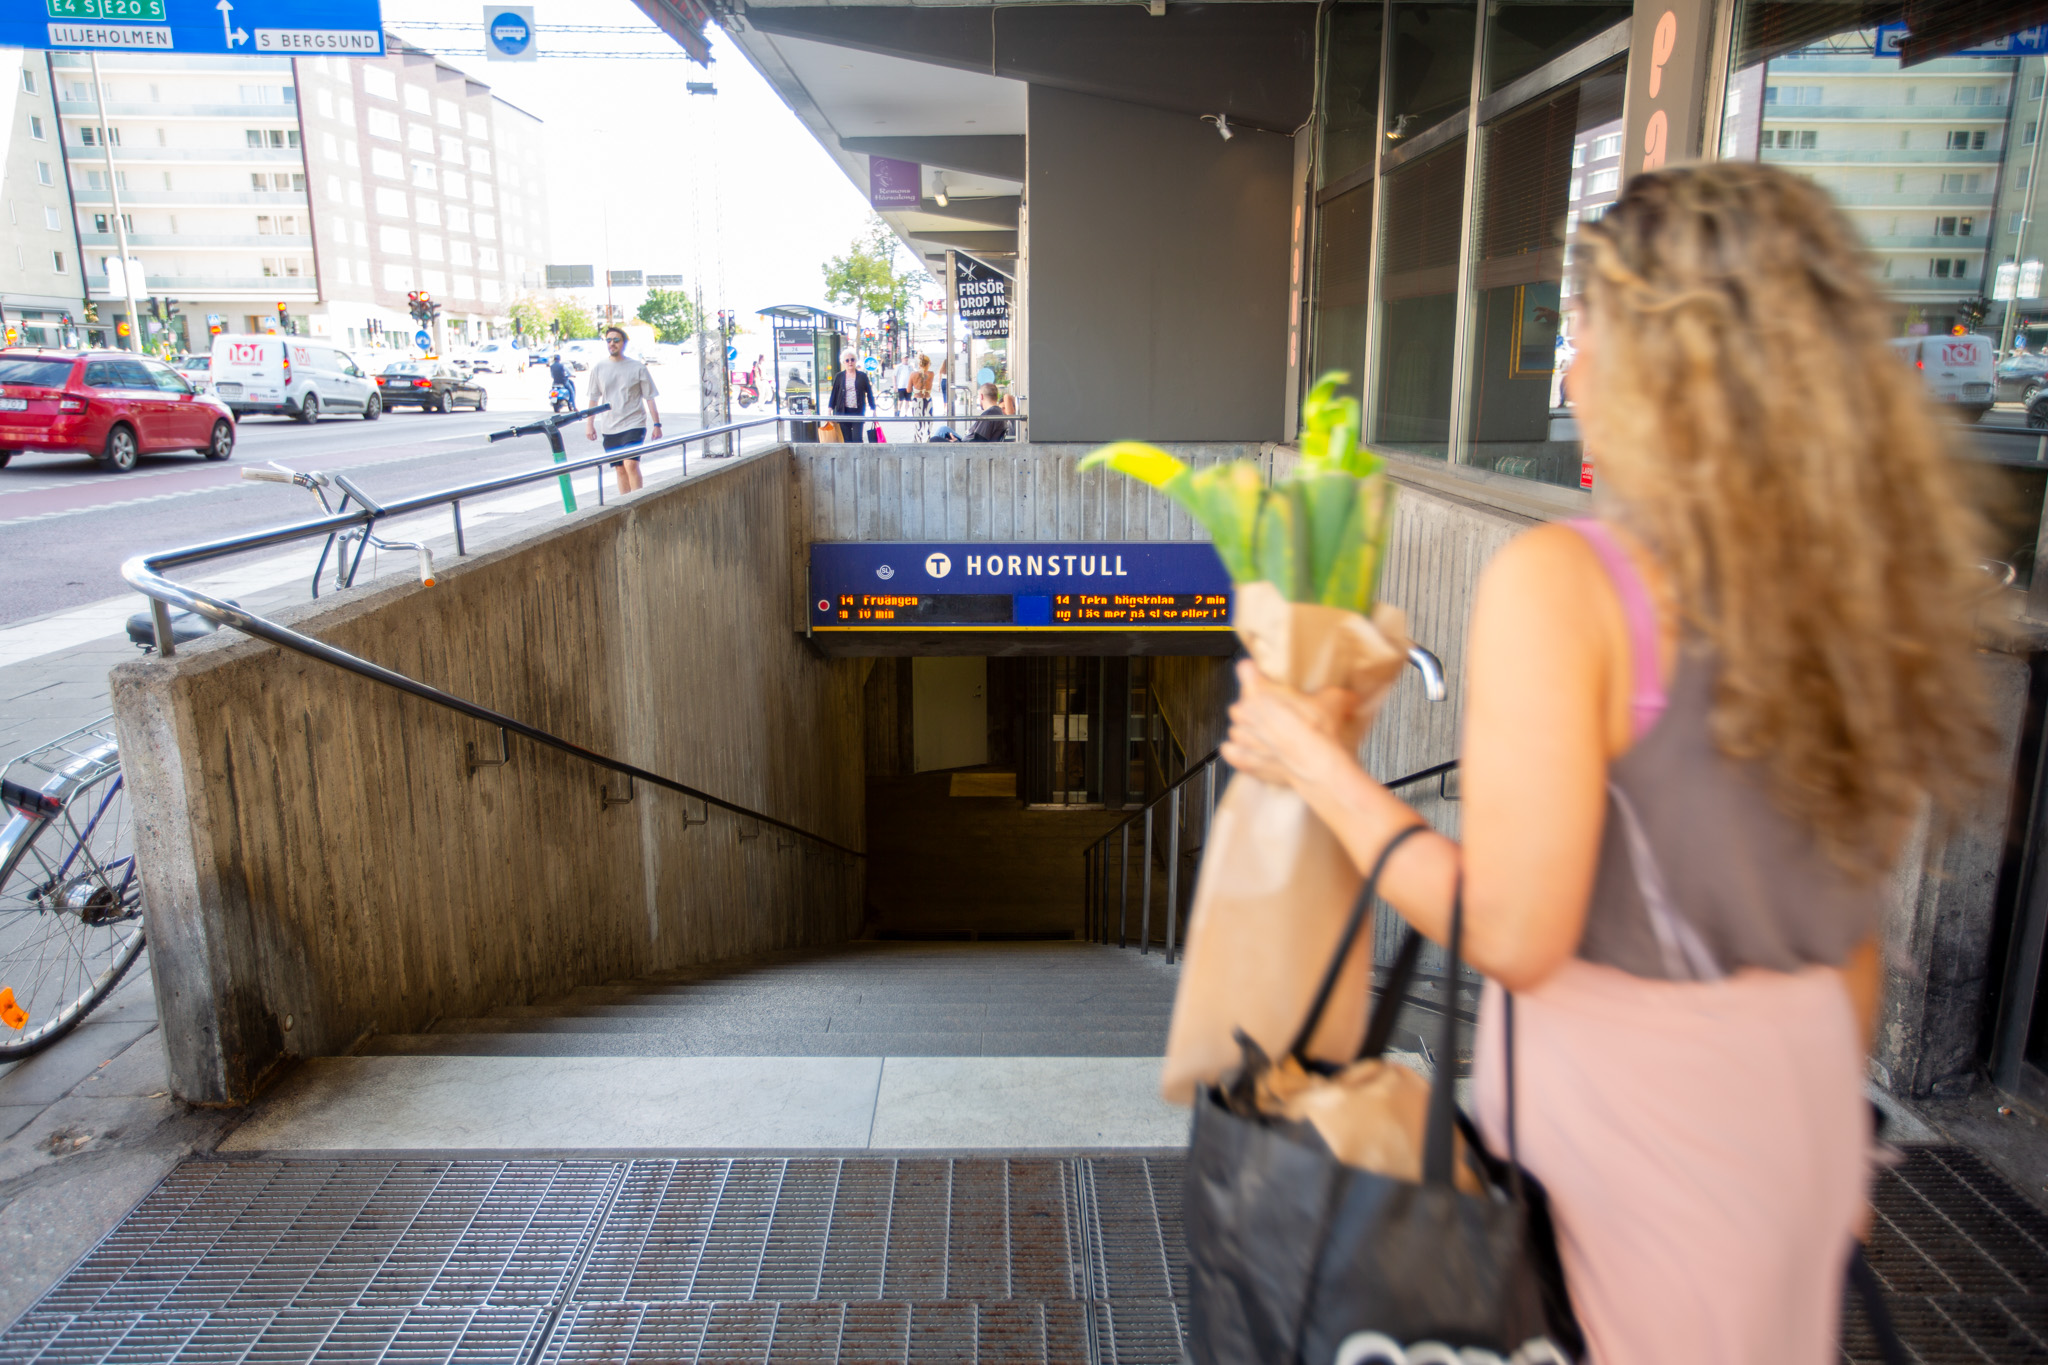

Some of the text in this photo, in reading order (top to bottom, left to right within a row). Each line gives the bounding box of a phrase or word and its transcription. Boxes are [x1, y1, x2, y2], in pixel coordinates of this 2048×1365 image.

[54, 0, 75, 12] E4
[104, 0, 161, 15] E20 S
[54, 28, 168, 45] LILJEHOLMEN
[260, 34, 374, 48] S BERGSUND
[958, 279, 1005, 296] FRISÖR
[960, 295, 1005, 308] DROP IN
[962, 309, 985, 317] 08-669
[996, 307, 1004, 315] 27
[973, 320, 1008, 329] DROP IN
[780, 331, 786, 339] A
[967, 555, 1128, 576] HORNSTULL
[1055, 595, 1070, 605] 14
[1206, 595, 1226, 605] min
[875, 608, 895, 619] min
